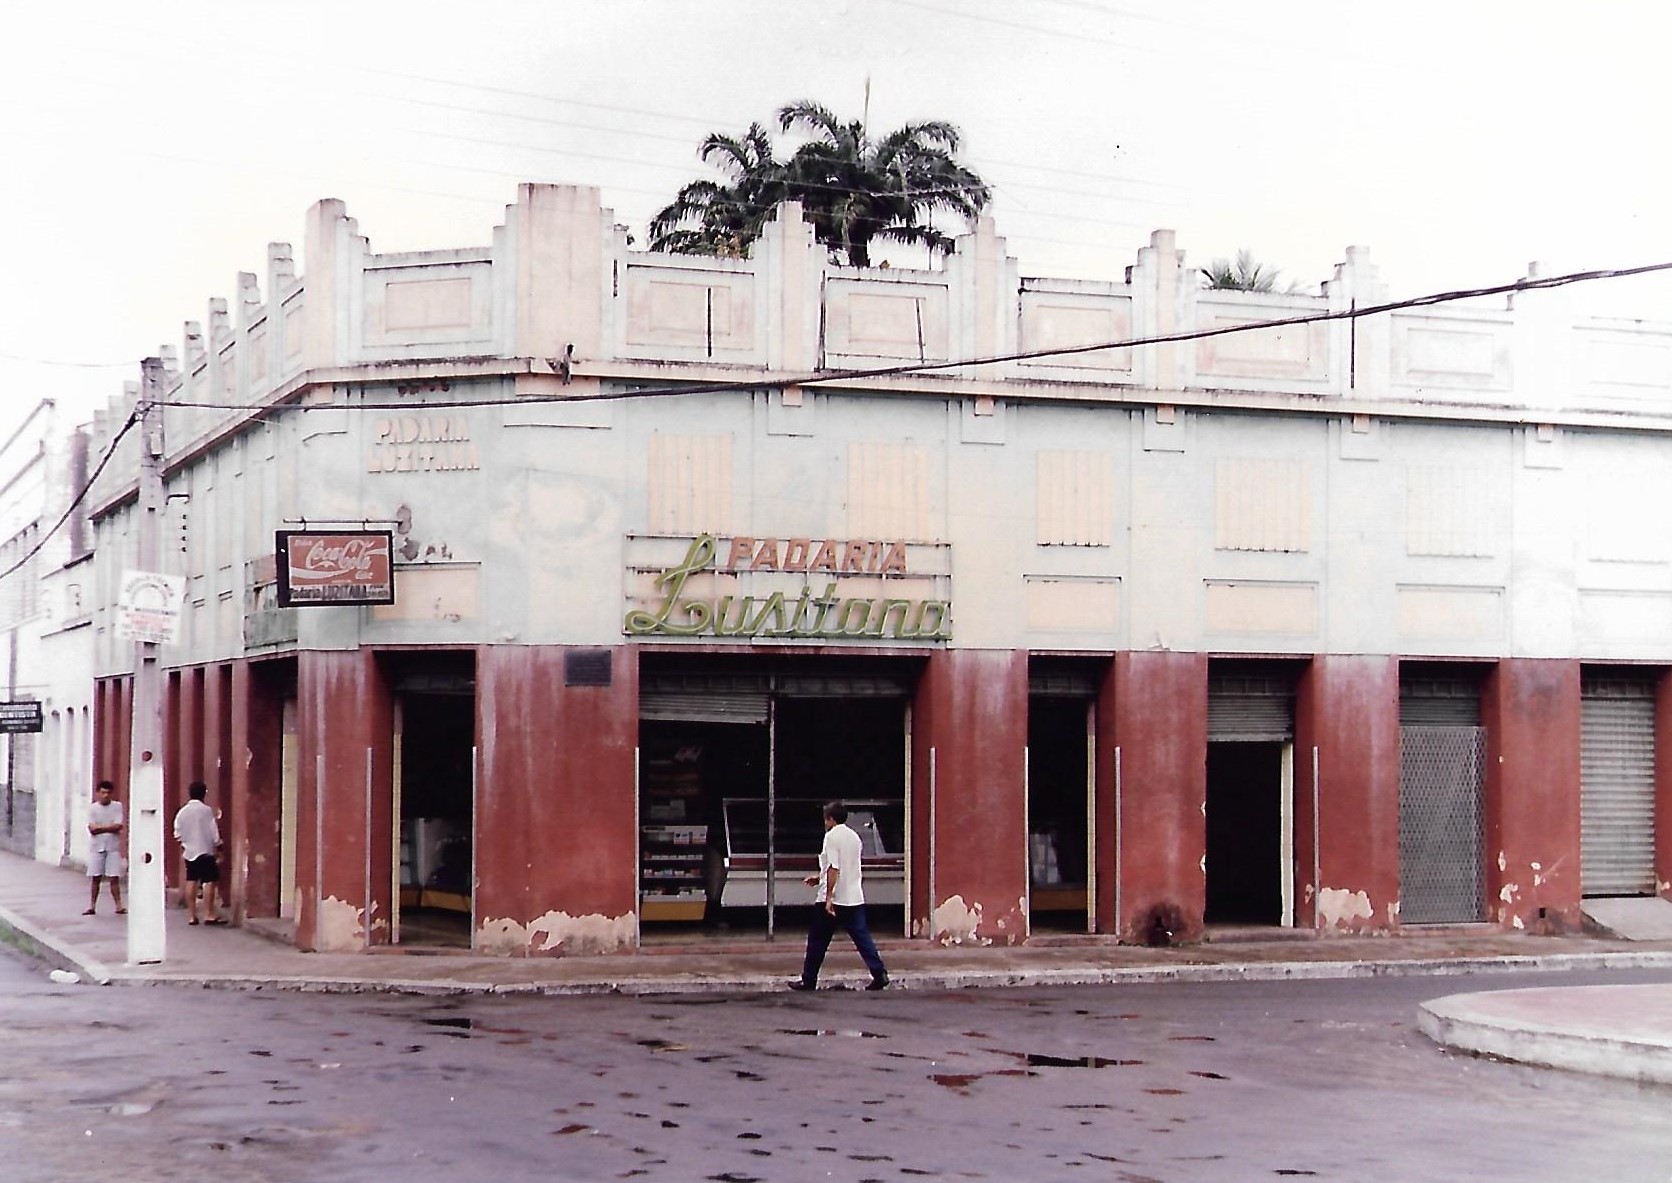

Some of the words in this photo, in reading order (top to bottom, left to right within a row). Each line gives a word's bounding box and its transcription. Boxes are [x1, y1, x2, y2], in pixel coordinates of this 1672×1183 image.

[373, 416, 470, 445] PADARIA
[727, 536, 907, 574] PADARIA
[625, 534, 951, 638] Lusitana
